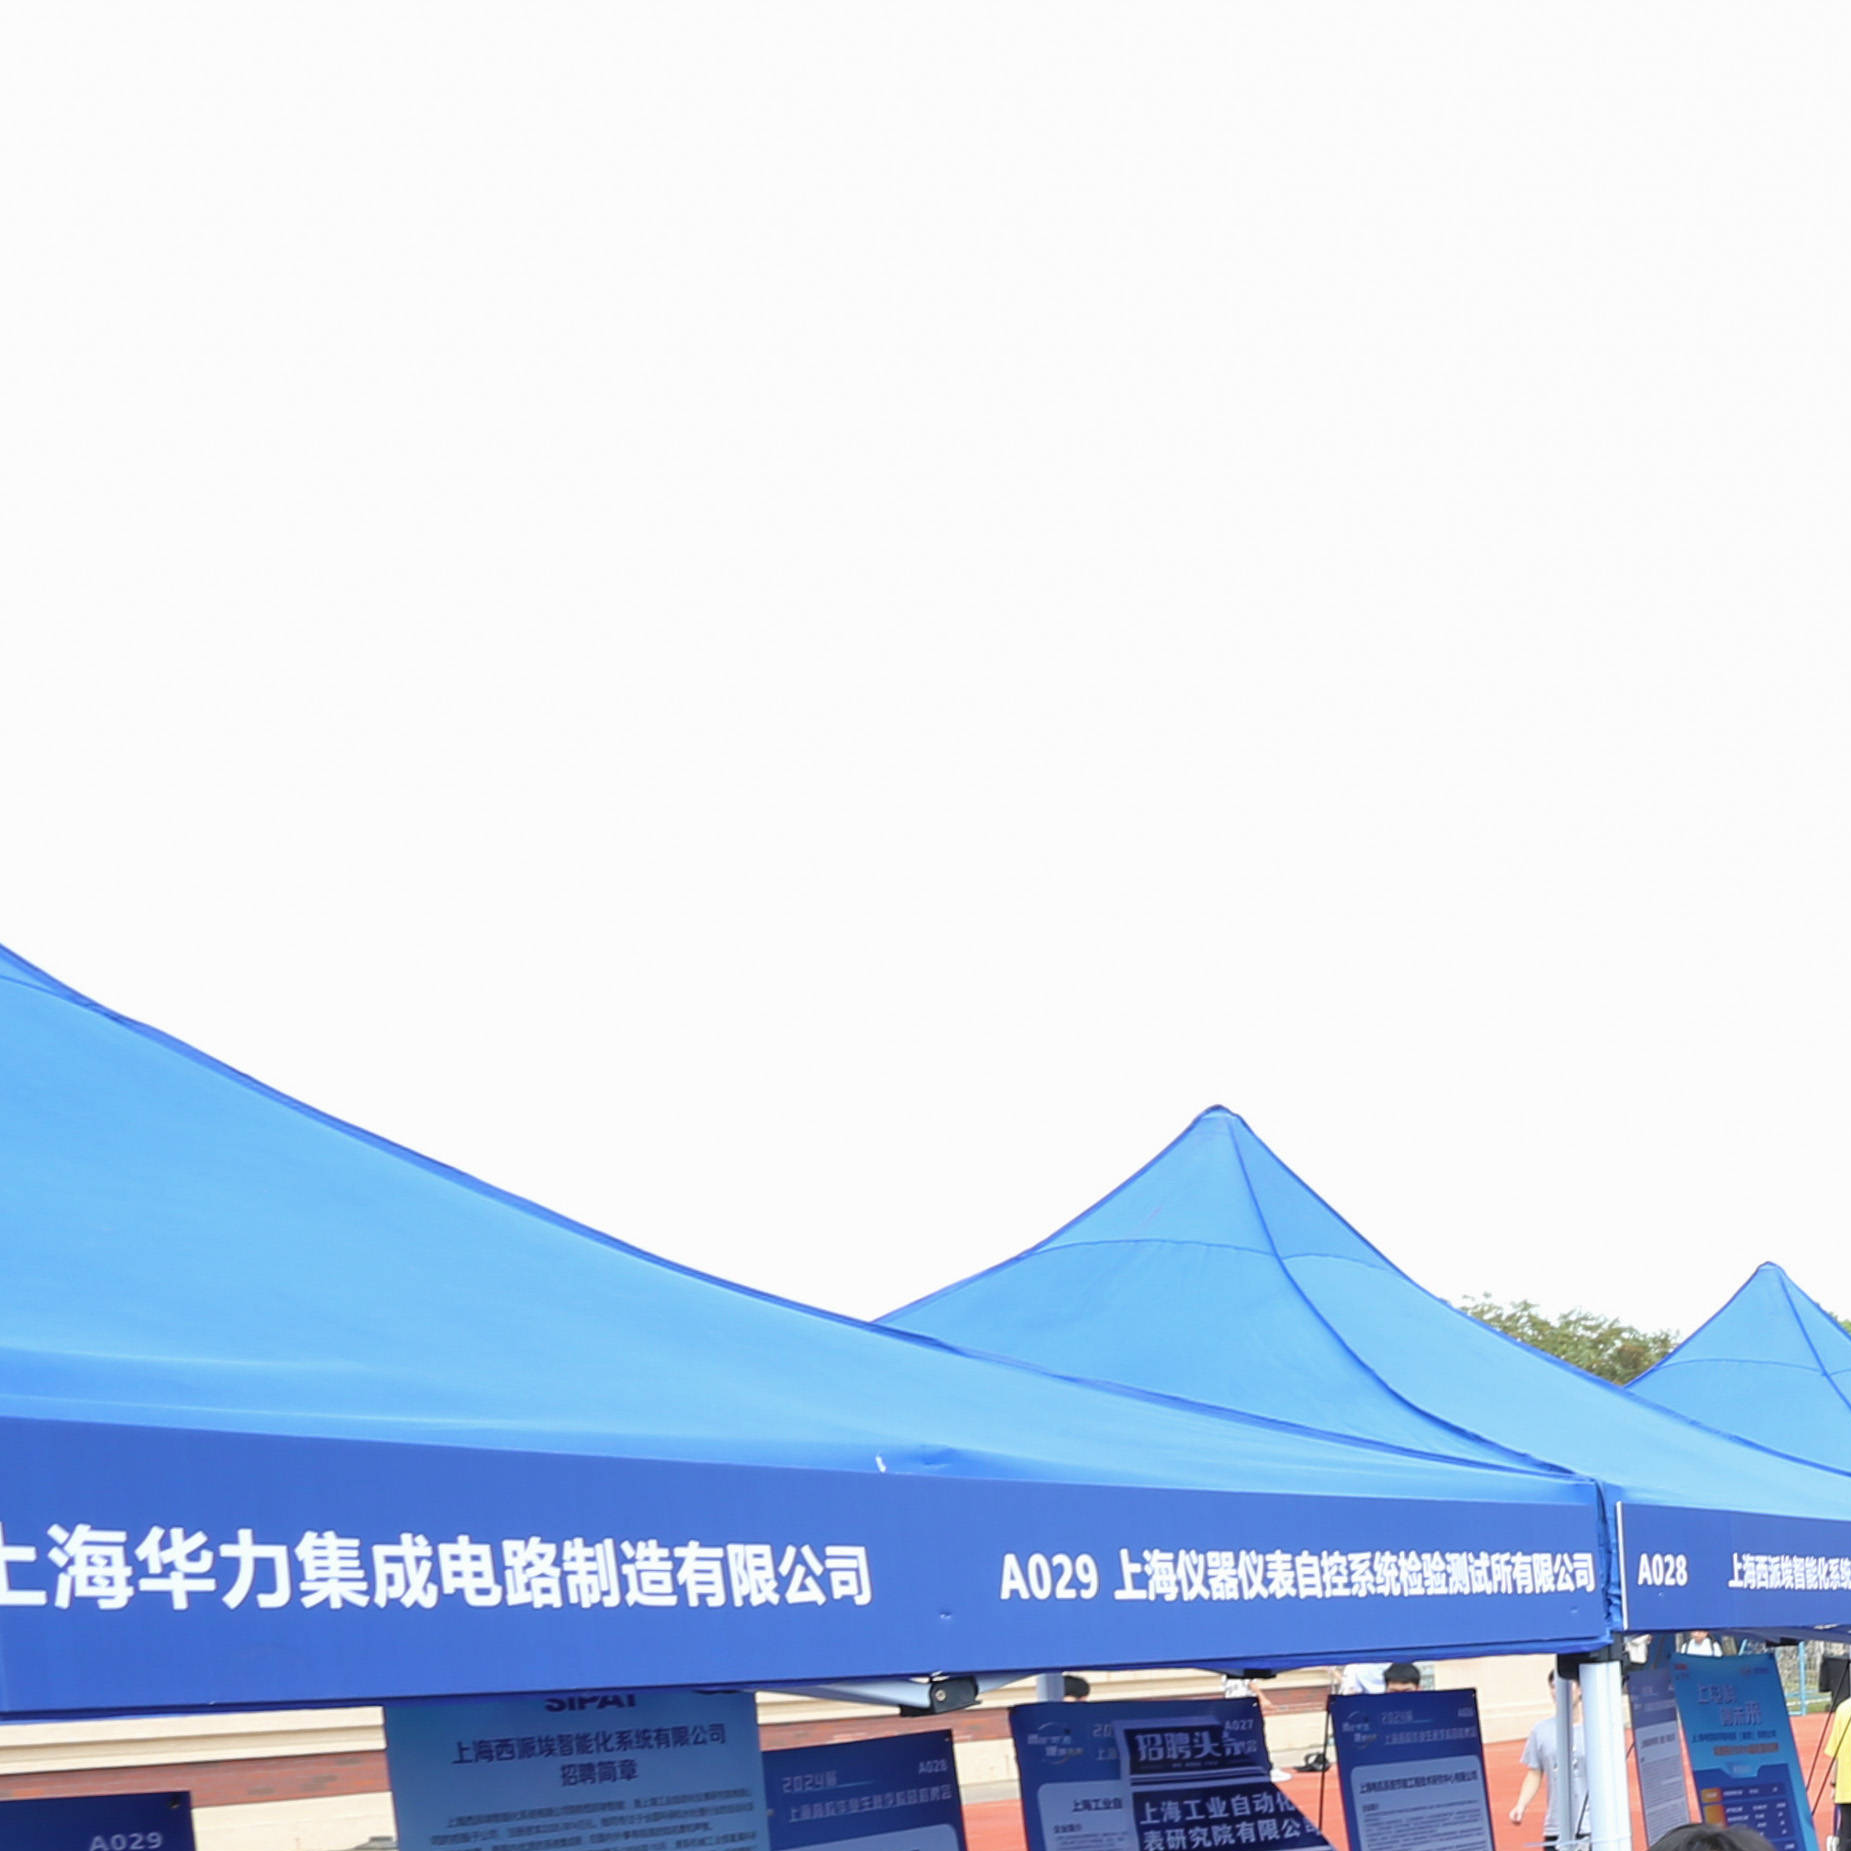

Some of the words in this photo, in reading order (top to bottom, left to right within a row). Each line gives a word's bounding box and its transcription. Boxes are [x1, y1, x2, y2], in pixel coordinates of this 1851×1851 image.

[0, 1522, 873, 1612] 上海华力集成电路制造有限公司
[1000, 1553, 1099, 1600] A029
[1114, 1548, 1595, 1602] 上海仪器仪表自控系统检验测试所有限公司
[1637, 1553, 1688, 1586] A028
[452, 1723, 727, 1766] 上海西派埃智能化系统有限公司
[560, 1758, 639, 1787] 招聘简章
